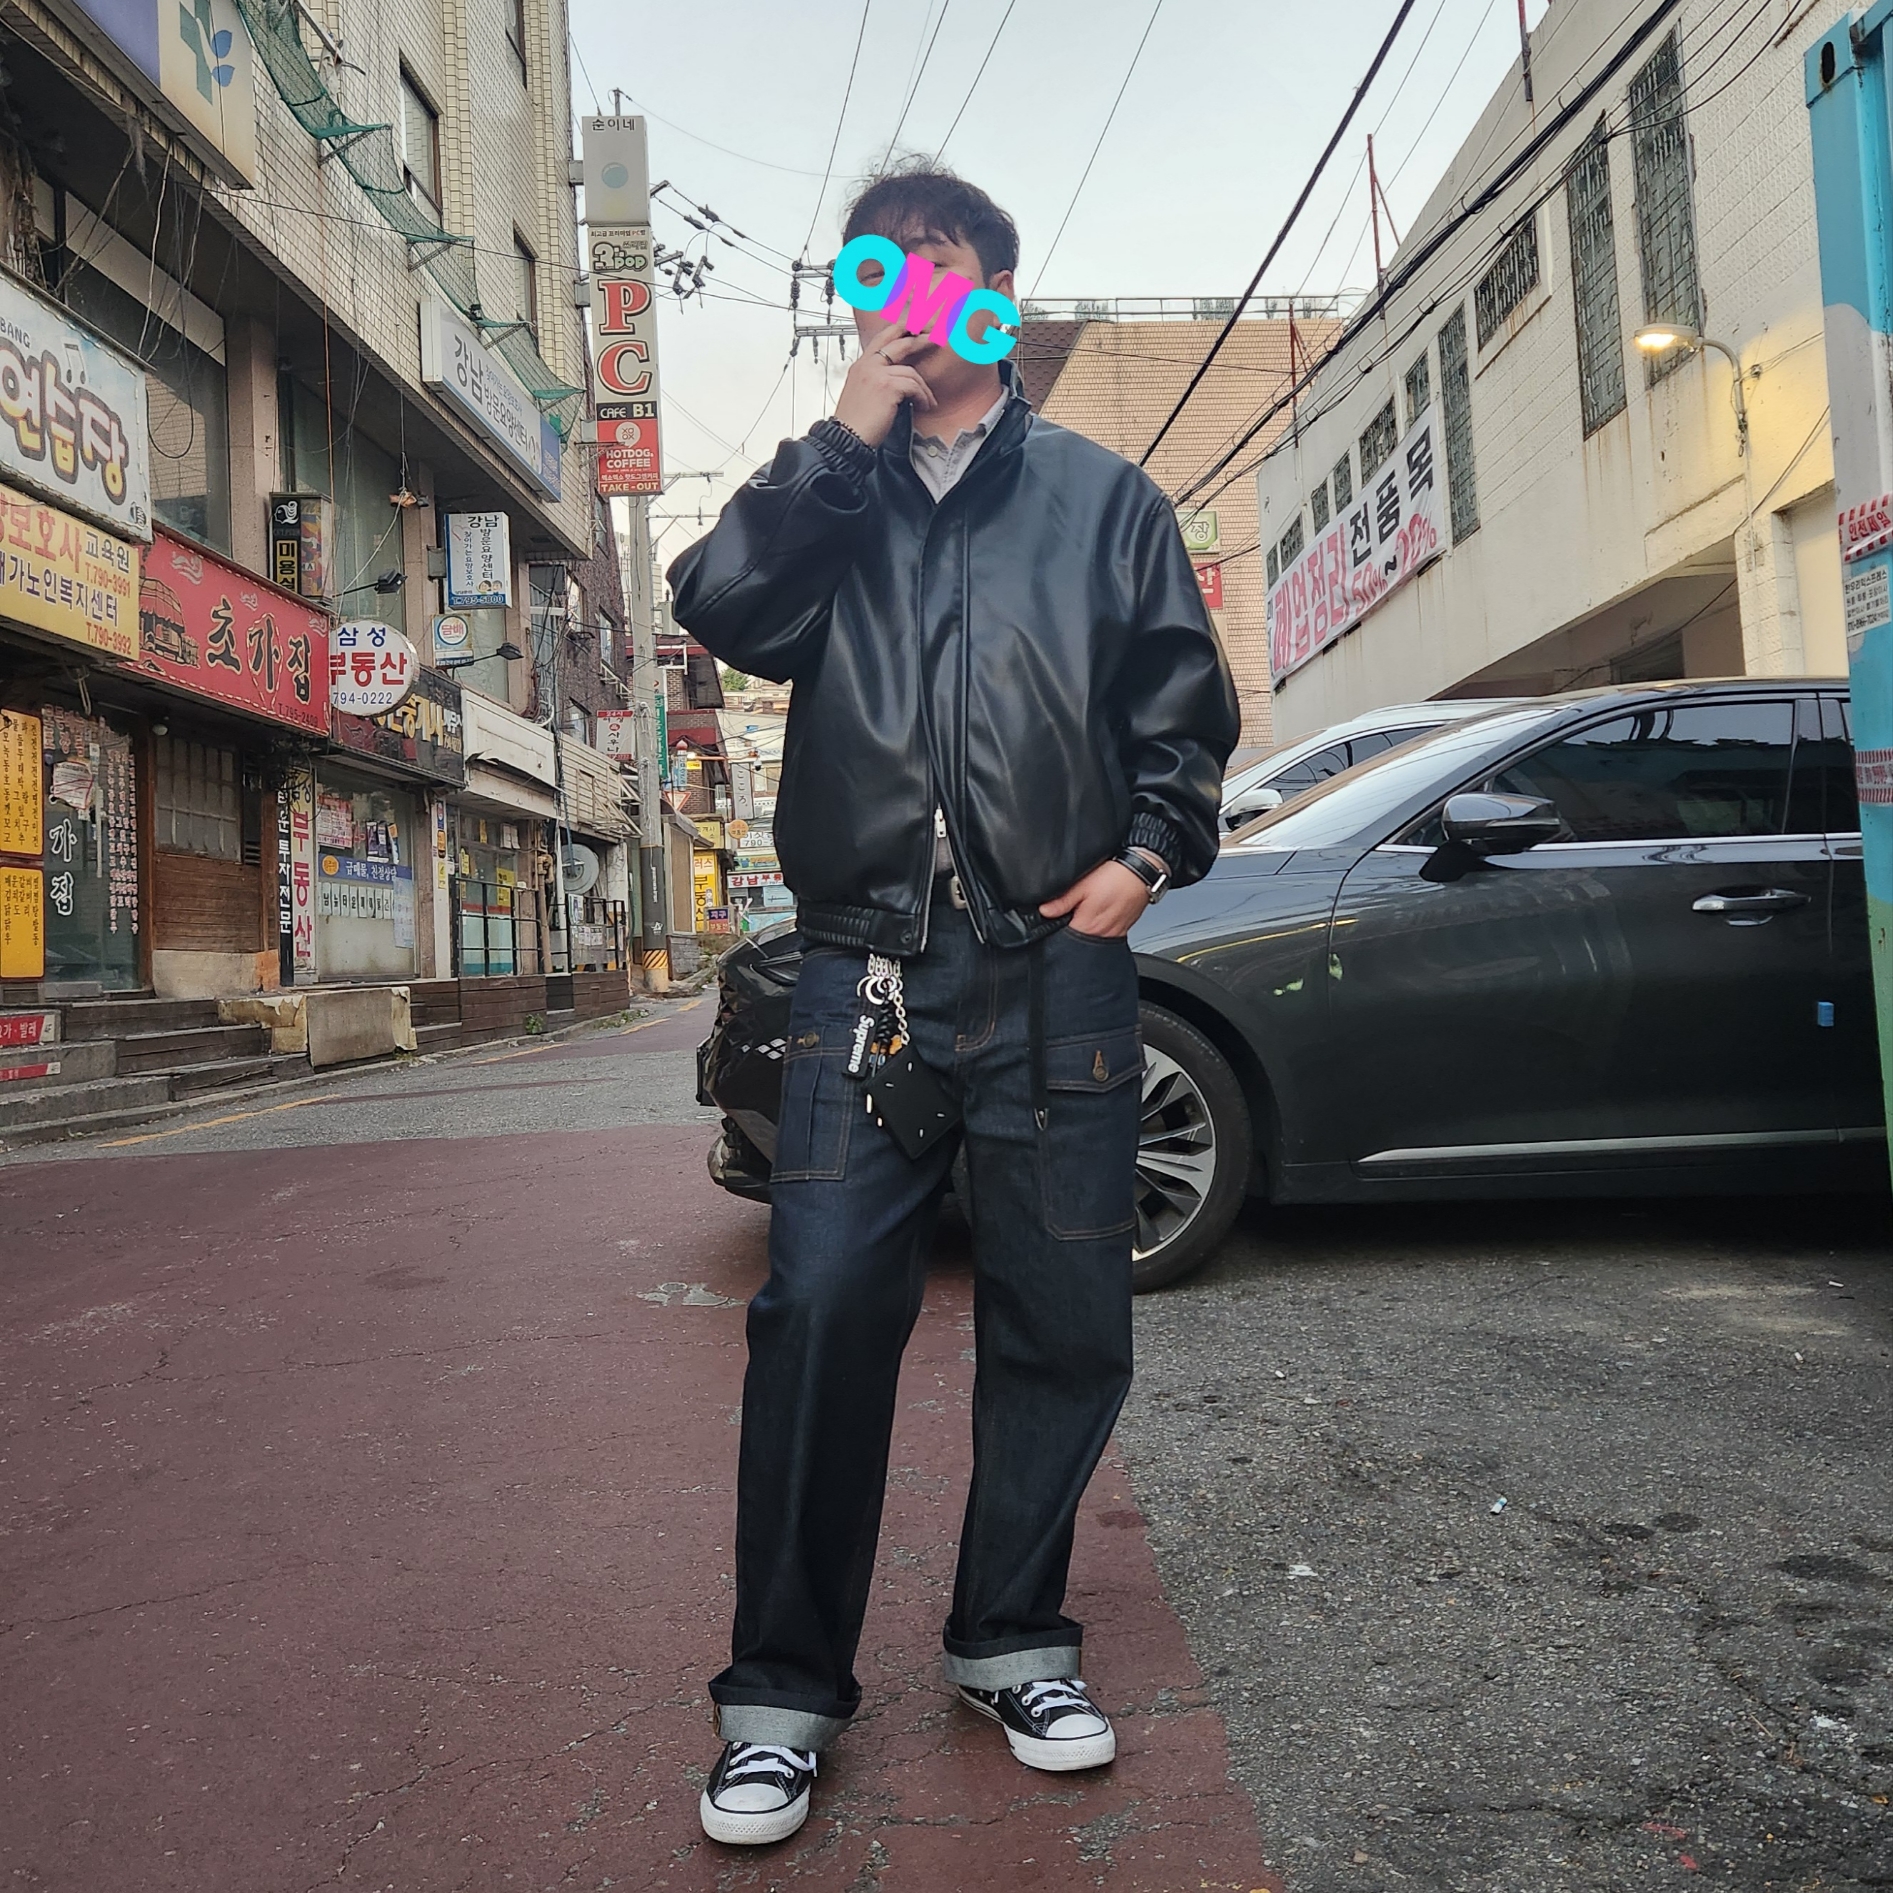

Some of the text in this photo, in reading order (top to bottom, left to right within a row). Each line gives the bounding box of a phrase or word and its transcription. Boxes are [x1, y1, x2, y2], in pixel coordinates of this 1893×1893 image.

[591, 118, 635, 132] 순이네
[597, 277, 653, 398] PC
[454, 333, 528, 452] 강남 방문요양센터
[600, 403, 655, 418] CAFE B1
[606, 458, 651, 468] COFFEE
[601, 481, 659, 493] TAKE-OUT
[467, 515, 500, 528] 강남
[86, 530, 130, 574] 교육원
[480, 528, 494, 580] 방문요양센터
[1273, 424, 1434, 672] 폐업정리 전품목
[338, 626, 387, 648] 삼성
[441, 622, 465, 636] 담배
[207, 595, 313, 704] 초가집
[329, 652, 408, 687] 부동산
[332, 692, 393, 706] 794-0222
[694, 858, 713, 870] 러스
[291, 808, 313, 959] 부동산
[731, 873, 783, 887] 강남 부동
[20, 1021, 37, 1039] 발레
[847, 1014, 875, 1074] Supreme
